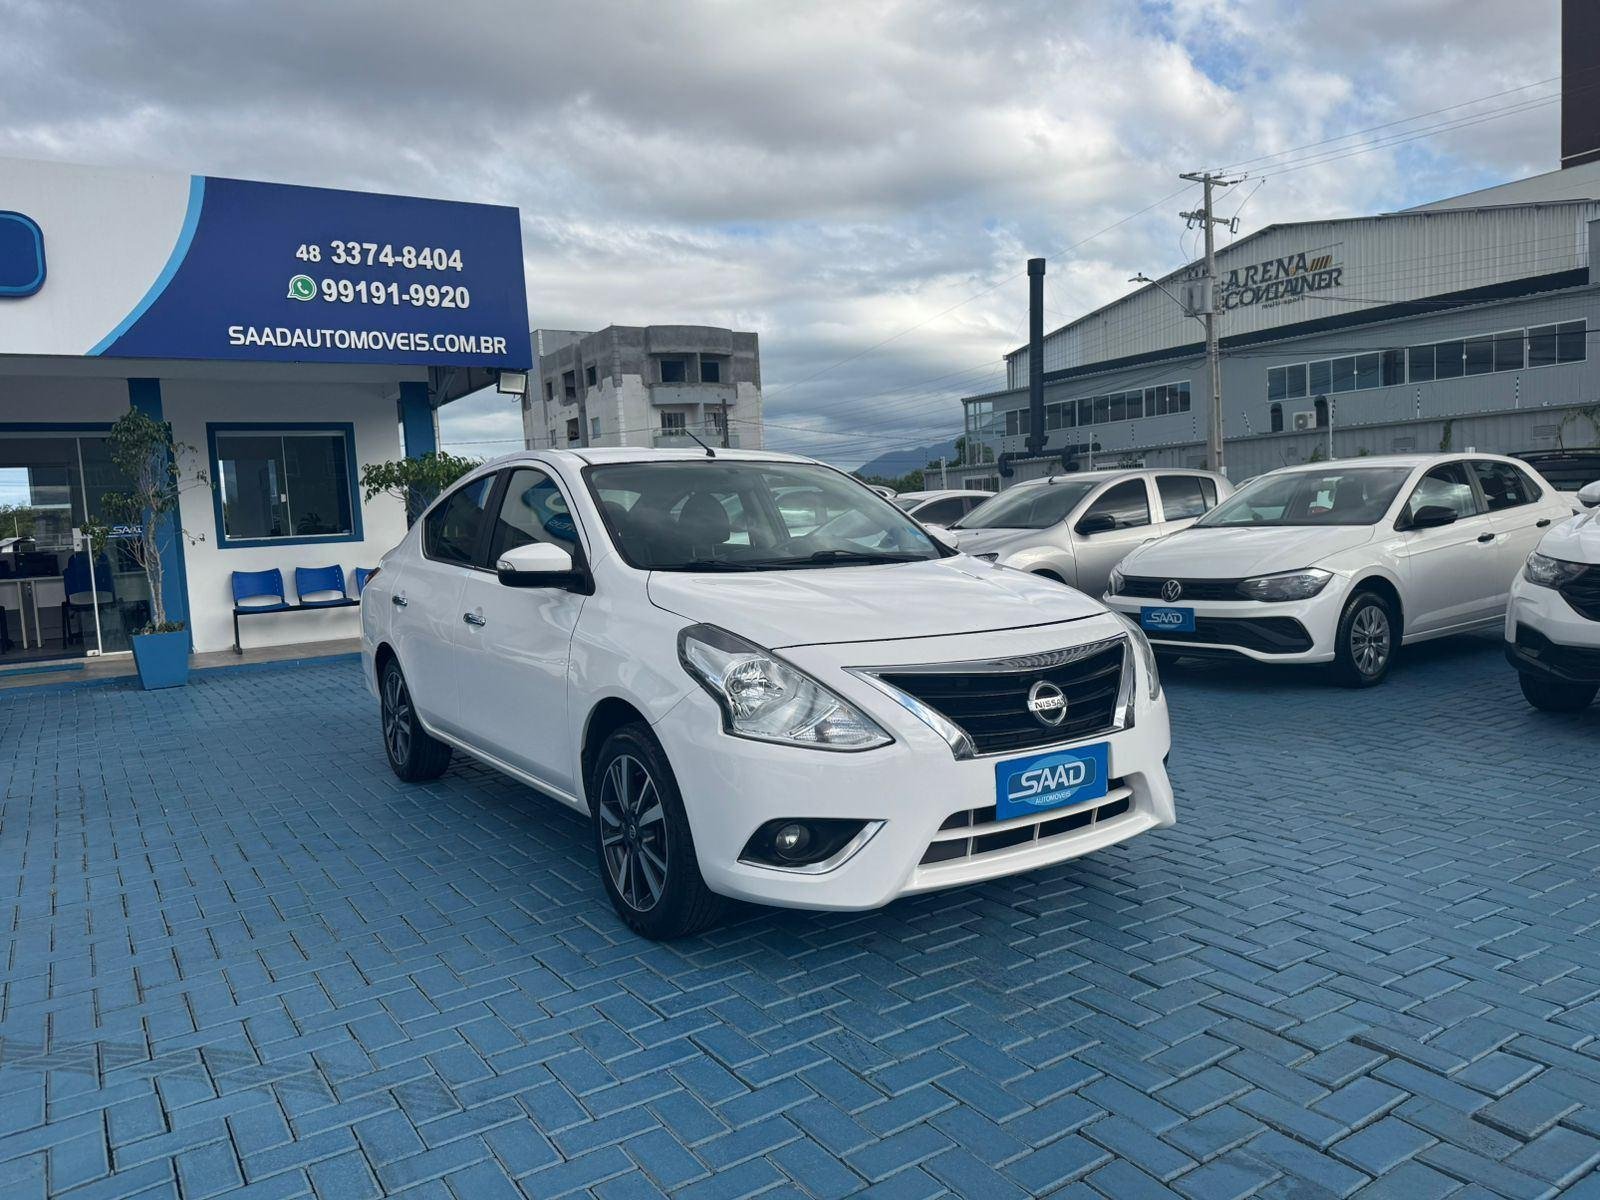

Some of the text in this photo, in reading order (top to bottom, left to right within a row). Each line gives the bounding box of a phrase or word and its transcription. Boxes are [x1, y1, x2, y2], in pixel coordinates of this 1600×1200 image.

[296, 240, 464, 272] 48 3374-8404
[1224, 252, 1309, 292] ARENA
[322, 278, 471, 310] 99191-9920
[1225, 267, 1343, 310] CONTAINER
[228, 325, 508, 355] SAADAUTOMOVEIS.COM.BR
[1145, 612, 1183, 624] SAAD
[1008, 761, 1086, 799] SAAD
